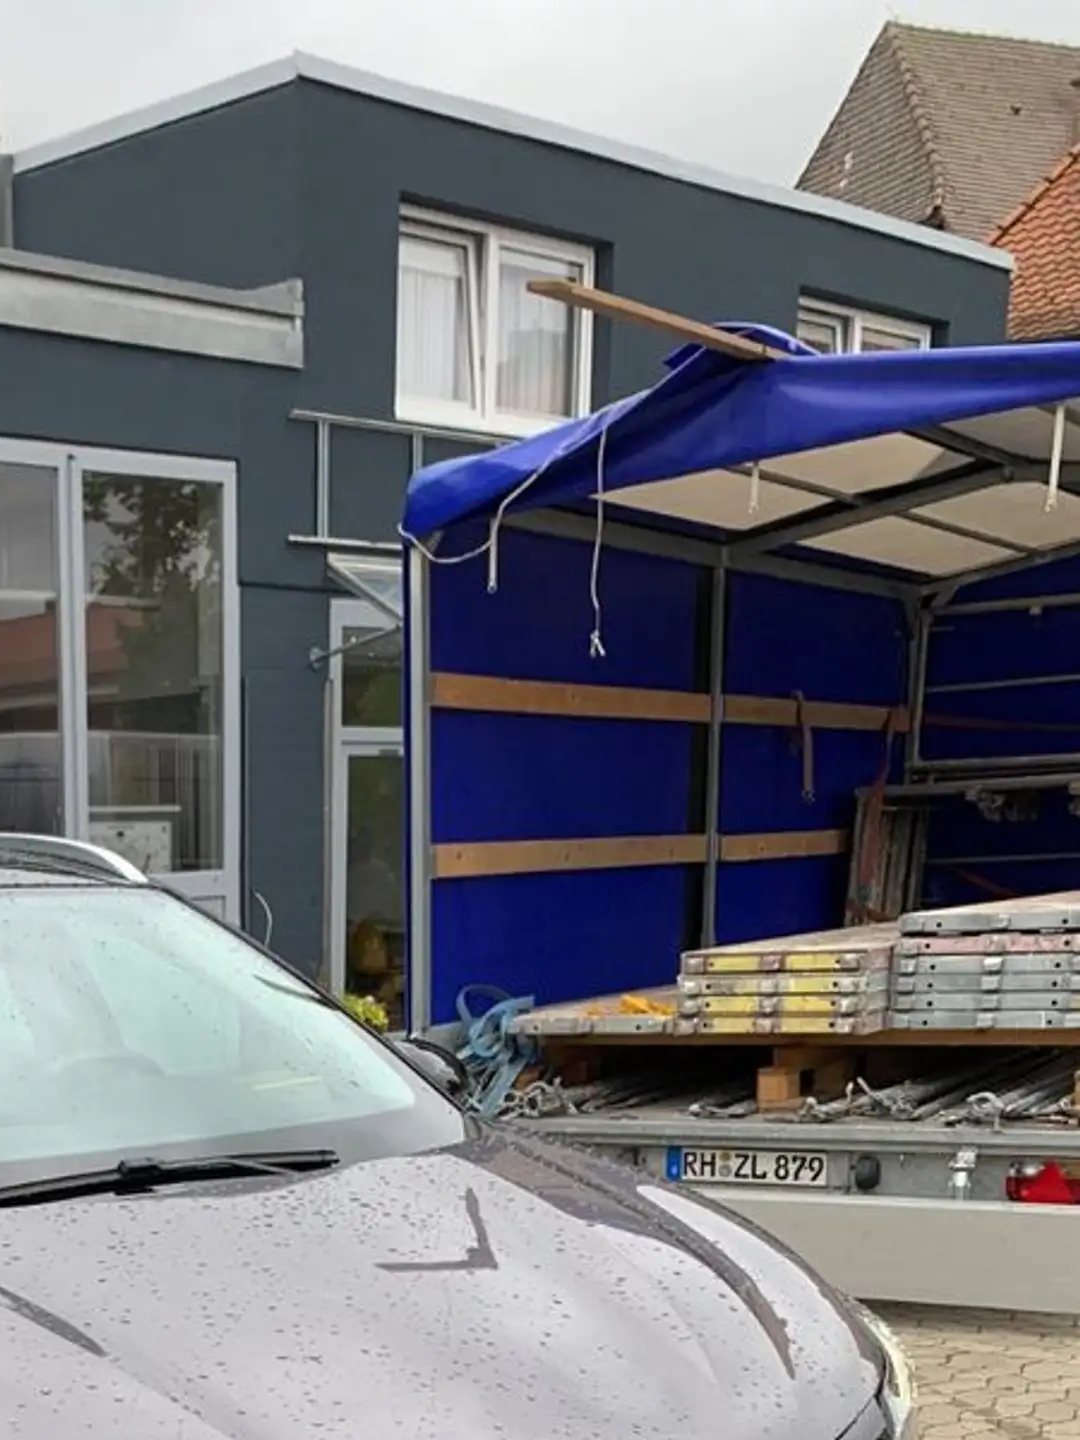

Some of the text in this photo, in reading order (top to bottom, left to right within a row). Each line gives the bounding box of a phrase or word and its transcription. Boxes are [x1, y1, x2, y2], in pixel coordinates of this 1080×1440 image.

[683, 1151, 717, 1178] RH
[734, 1153, 768, 1180] ZL
[773, 1154, 825, 1182] 879
